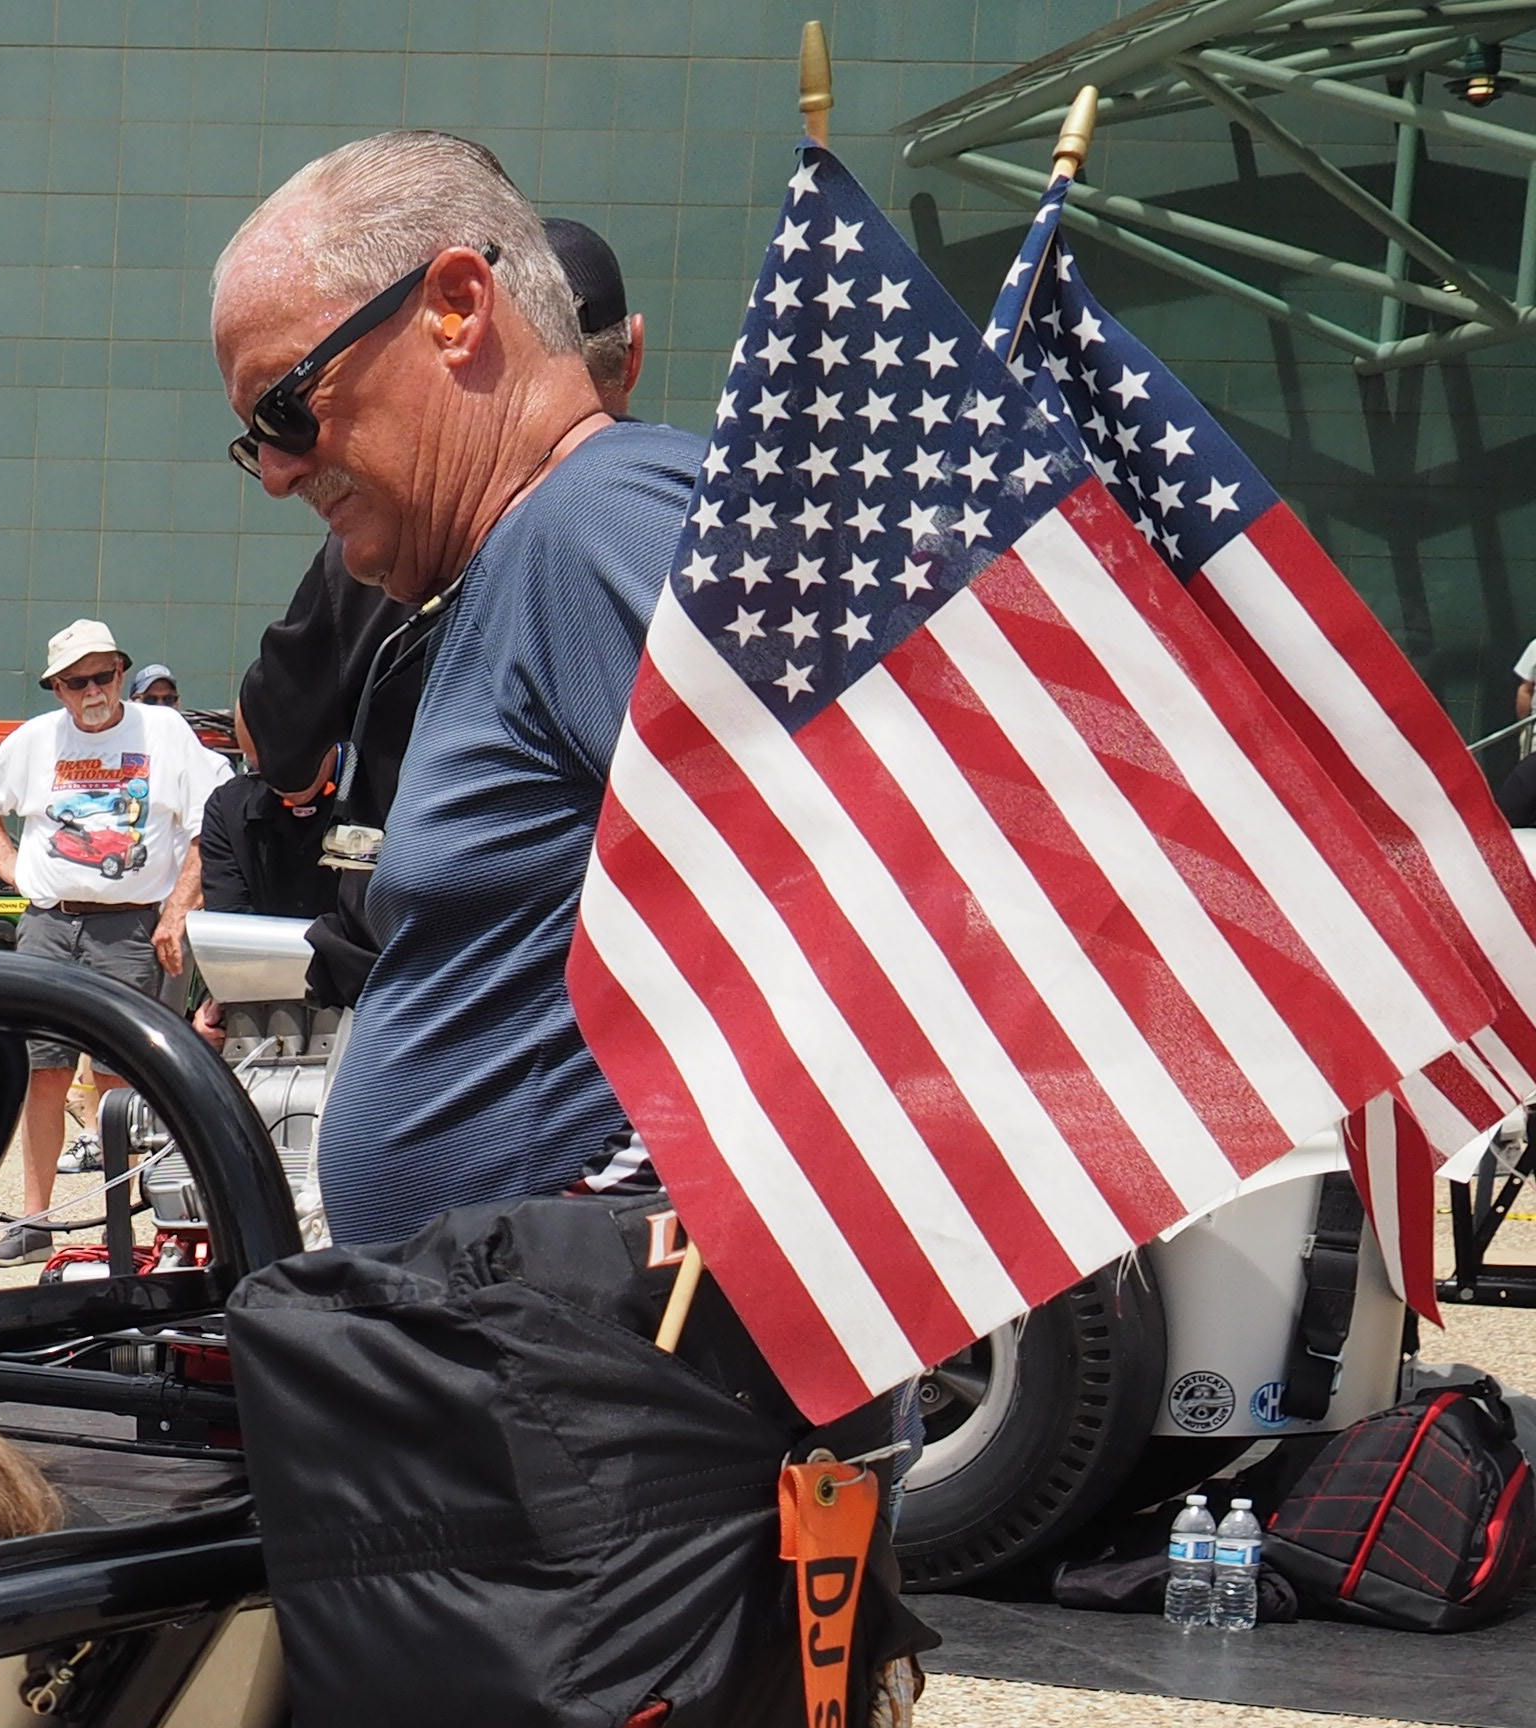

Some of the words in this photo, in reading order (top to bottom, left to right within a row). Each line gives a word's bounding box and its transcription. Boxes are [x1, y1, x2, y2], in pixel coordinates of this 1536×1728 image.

[1183, 1416, 1212, 1429] MOTOR
[1212, 1408, 1229, 1426] CLUB
[806, 1556, 857, 1668] DJ
